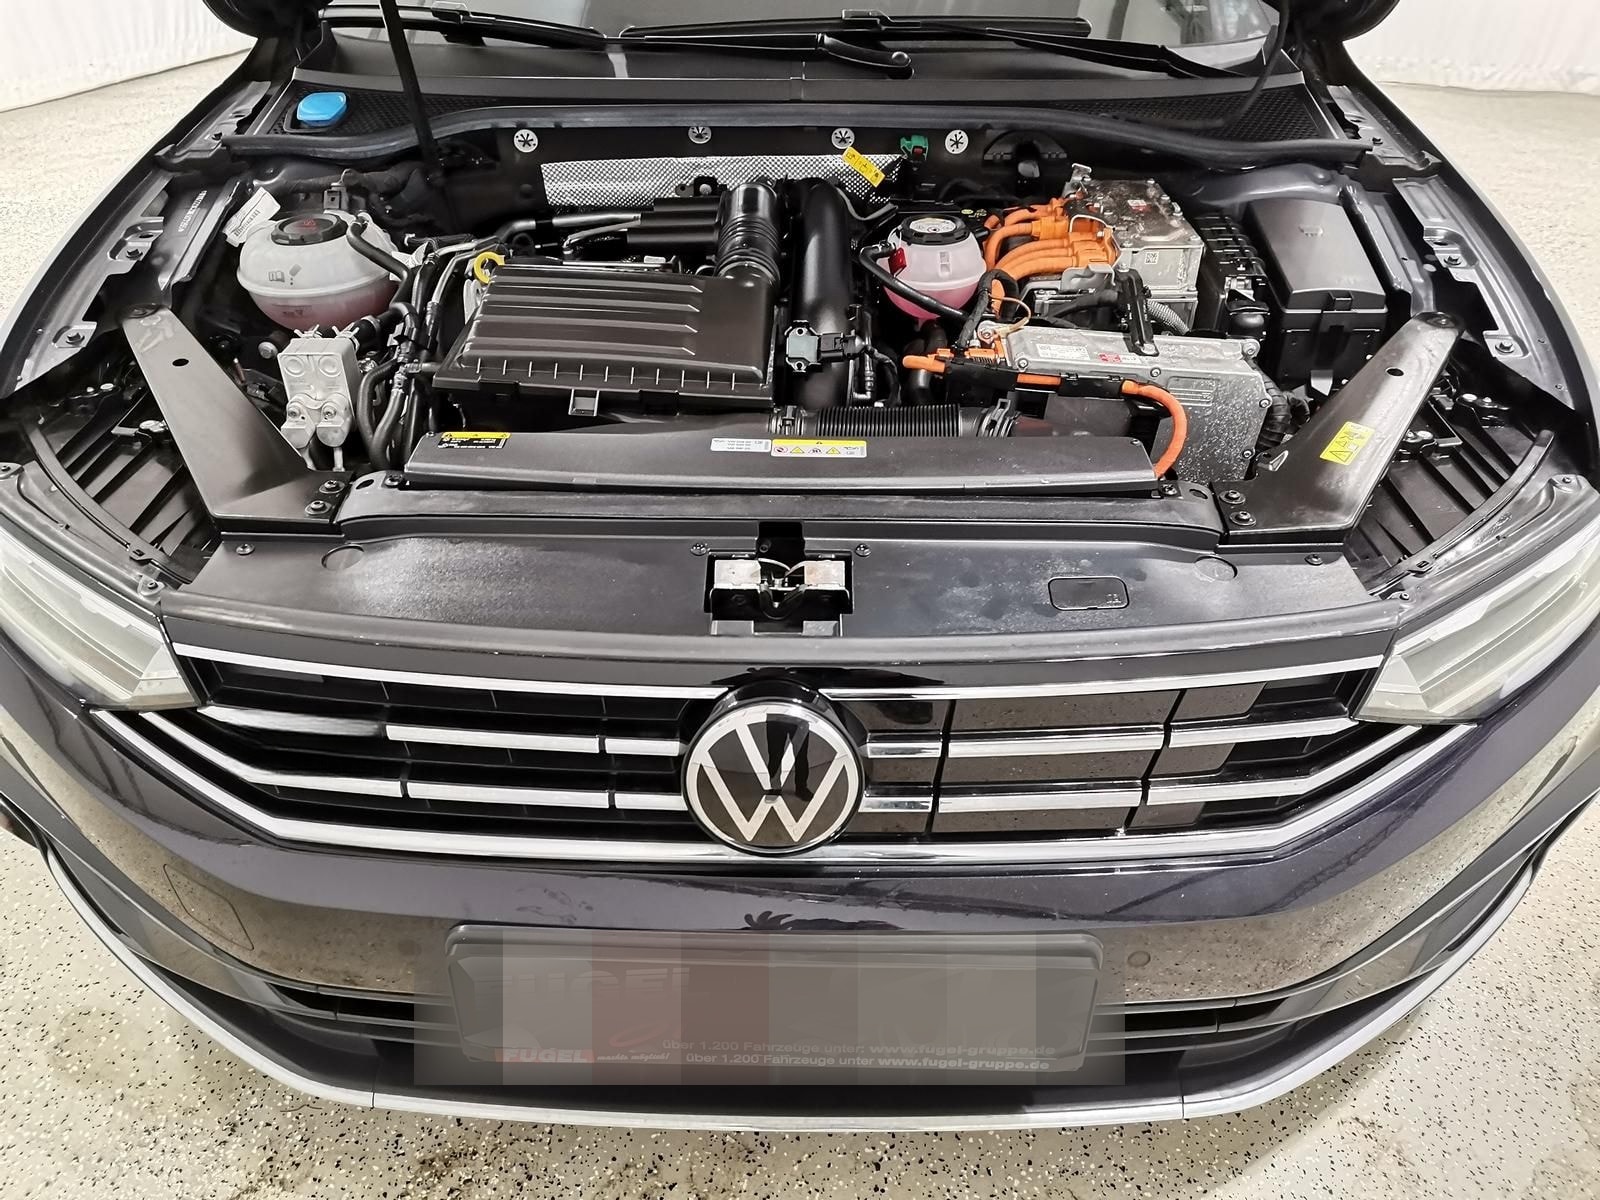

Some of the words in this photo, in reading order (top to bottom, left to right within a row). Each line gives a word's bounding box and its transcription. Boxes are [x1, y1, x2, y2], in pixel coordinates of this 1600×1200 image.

[685, 1052, 718, 1064] über
[721, 1054, 760, 1064] 1.200
[763, 1054, 836, 1067] Fahrzeuge
[838, 1056, 875, 1067] unter
[877, 1056, 1050, 1071] www.fugel-gruppe.de
